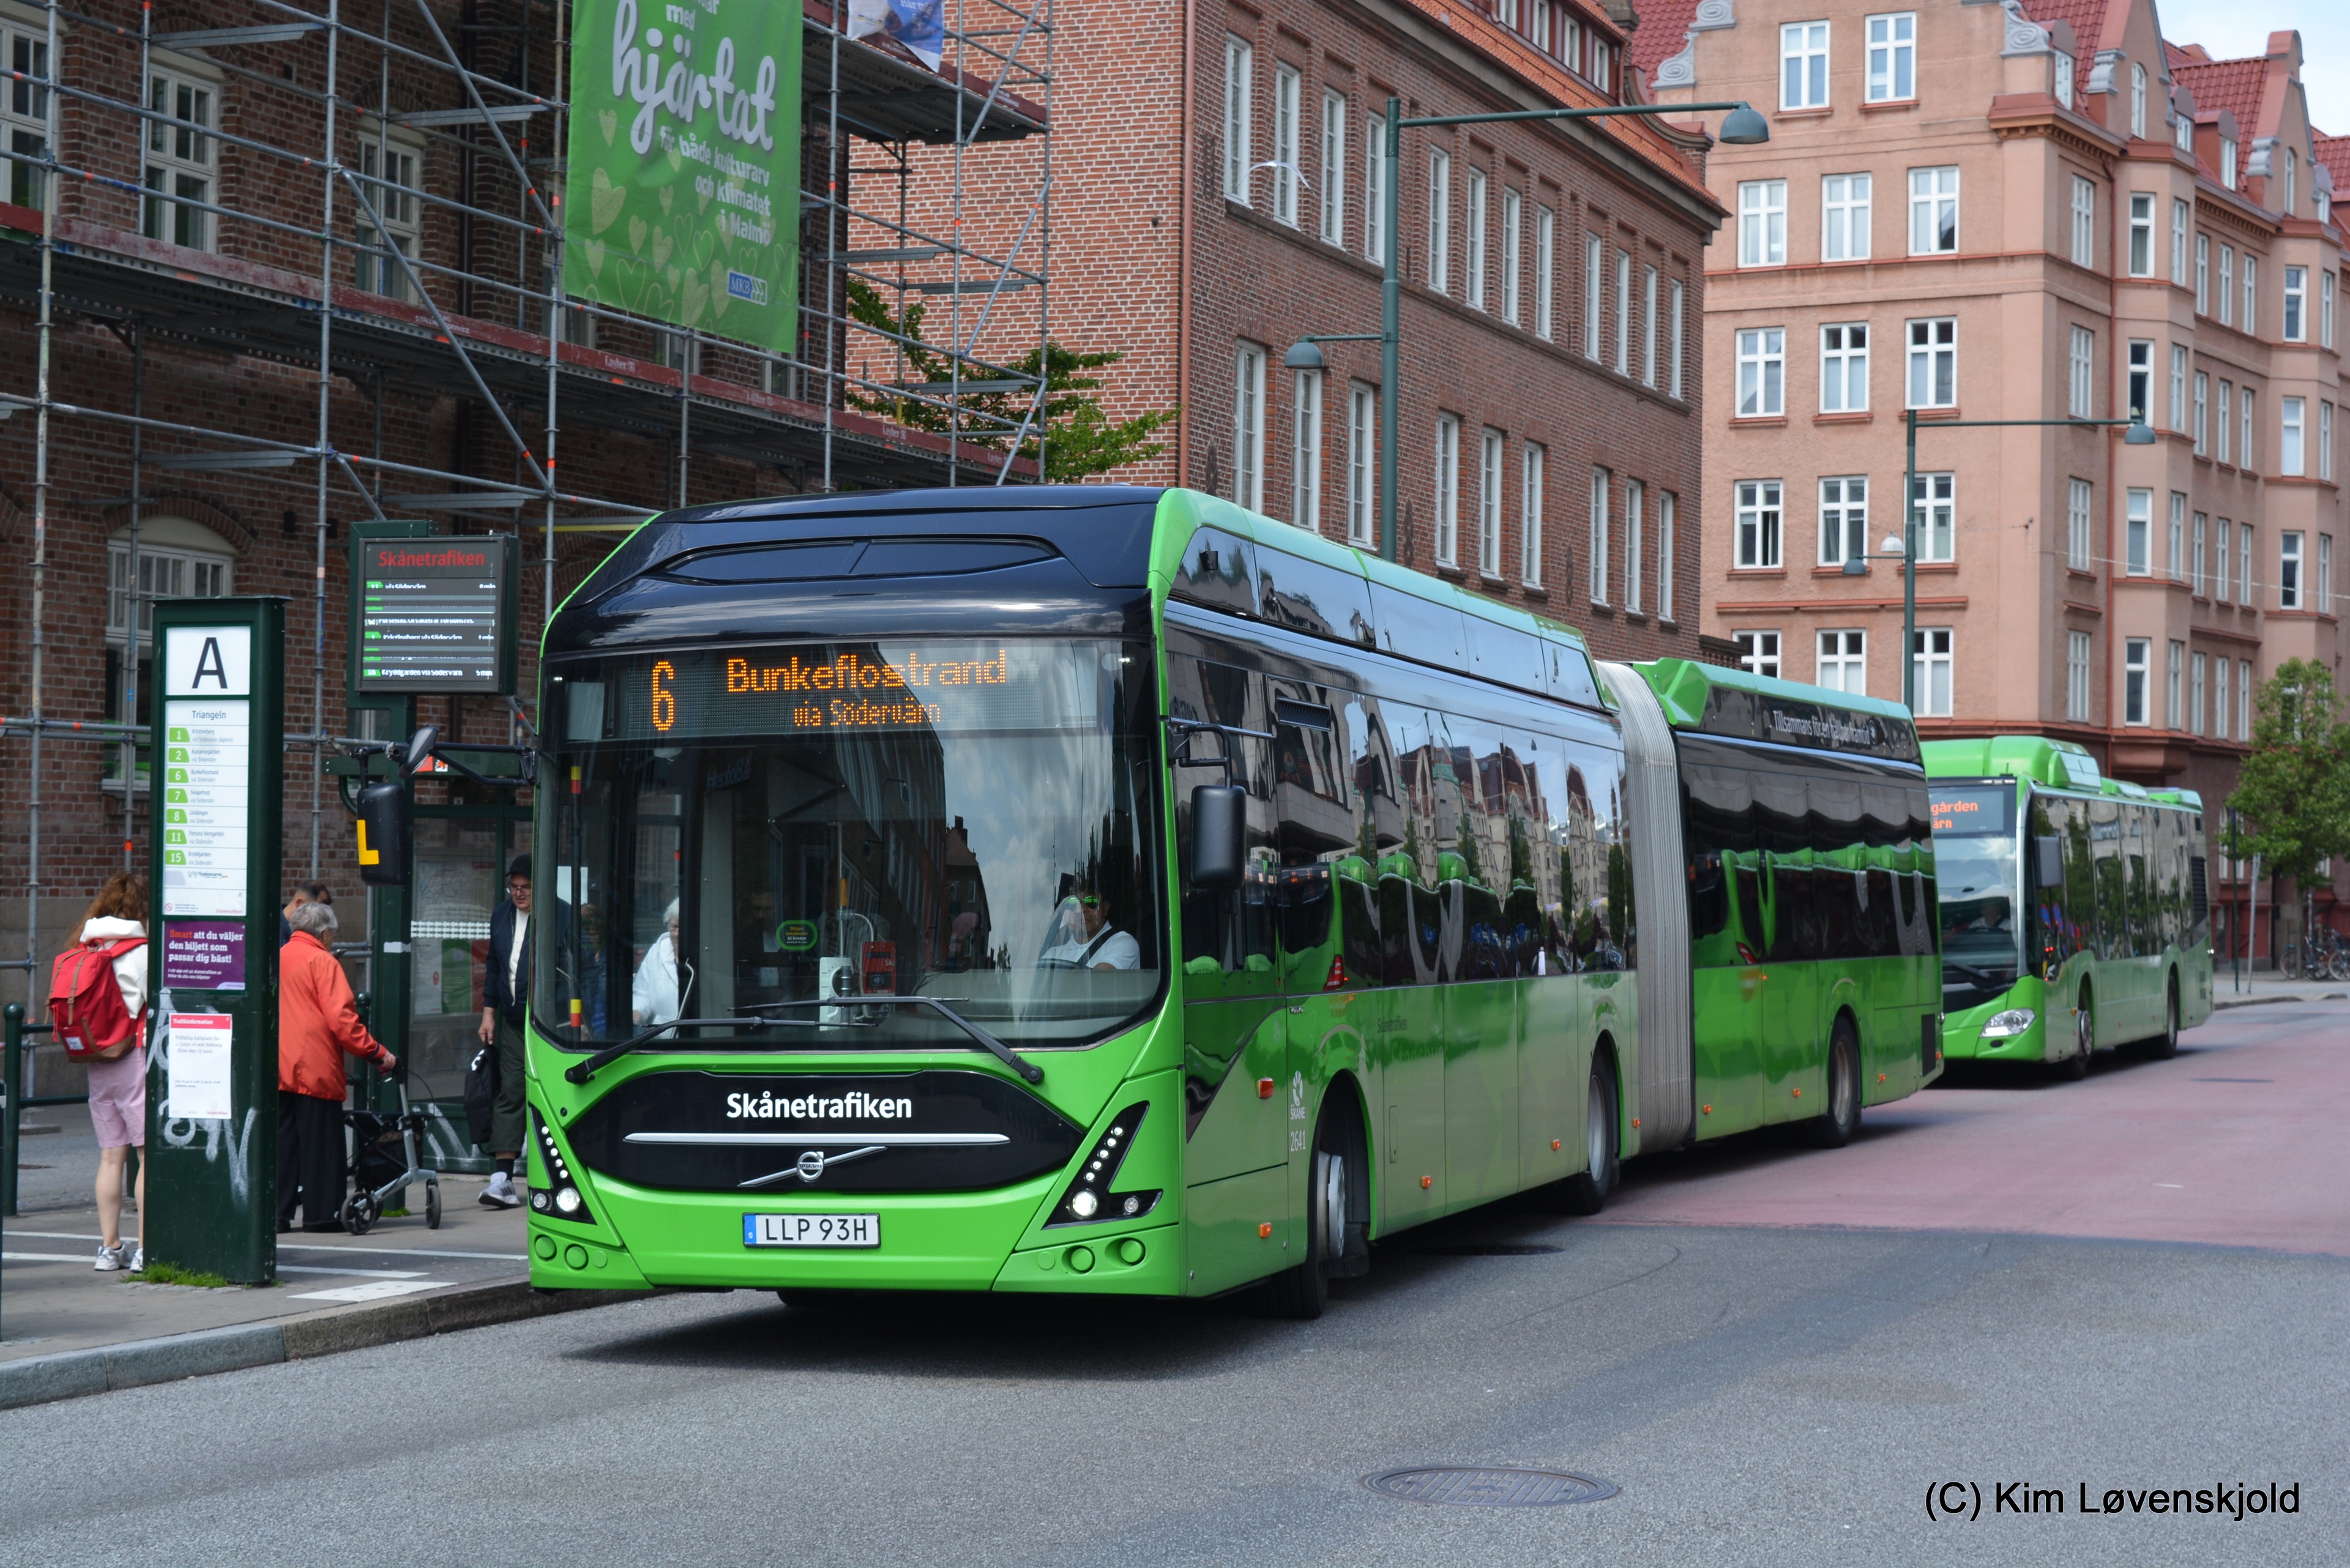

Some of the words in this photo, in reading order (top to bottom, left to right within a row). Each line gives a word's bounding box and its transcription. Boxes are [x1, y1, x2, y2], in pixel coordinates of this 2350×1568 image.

[666, 4, 695, 31] med
[613, 0, 775, 154] hjärtat
[660, 125, 675, 153] för
[679, 133, 712, 165] både
[714, 147, 770, 187] kulturarv
[695, 175, 714, 198] och
[717, 180, 770, 217] klimatet
[720, 209, 725, 231] i
[729, 212, 770, 246] Malmö
[731, 276, 750, 294] MKB
[379, 550, 485, 567] Skånetrafiken
[192, 637, 228, 689] A
[728, 650, 1006, 692] Bunkeflostrand
[652, 661, 674, 731] 6
[192, 711, 226, 720] Triangeln
[794, 701, 821, 727] via
[830, 696, 941, 726] Södervärn
[1773, 710, 1813, 736] Tillsammans
[176, 730, 182, 740] 1
[176, 750, 182, 760] 2
[175, 771, 181, 780] 6
[175, 791, 181, 801] 7
[174, 811, 180, 821] 8
[1931, 800, 1979, 816] gården
[171, 832, 182, 842] 11
[171, 853, 182, 862] 15
[170, 930, 193, 938] Smart
[193, 931, 206, 939] att
[206, 931, 218, 939] du
[218, 931, 244, 942] väljer
[169, 941, 184, 949] den
[185, 941, 209, 952] biljett
[168, 954, 195, 962] passar
[195, 954, 209, 964] dig
[211, 954, 232, 963] bäst!
[1377, 1016, 1407, 1033] Skånetrafiken
[726, 1091, 912, 1118] Skånetrafiken
[1290, 1130, 1306, 1151] 2641
[766, 1219, 810, 1241] LLP
[819, 1219, 867, 1241] 93H
